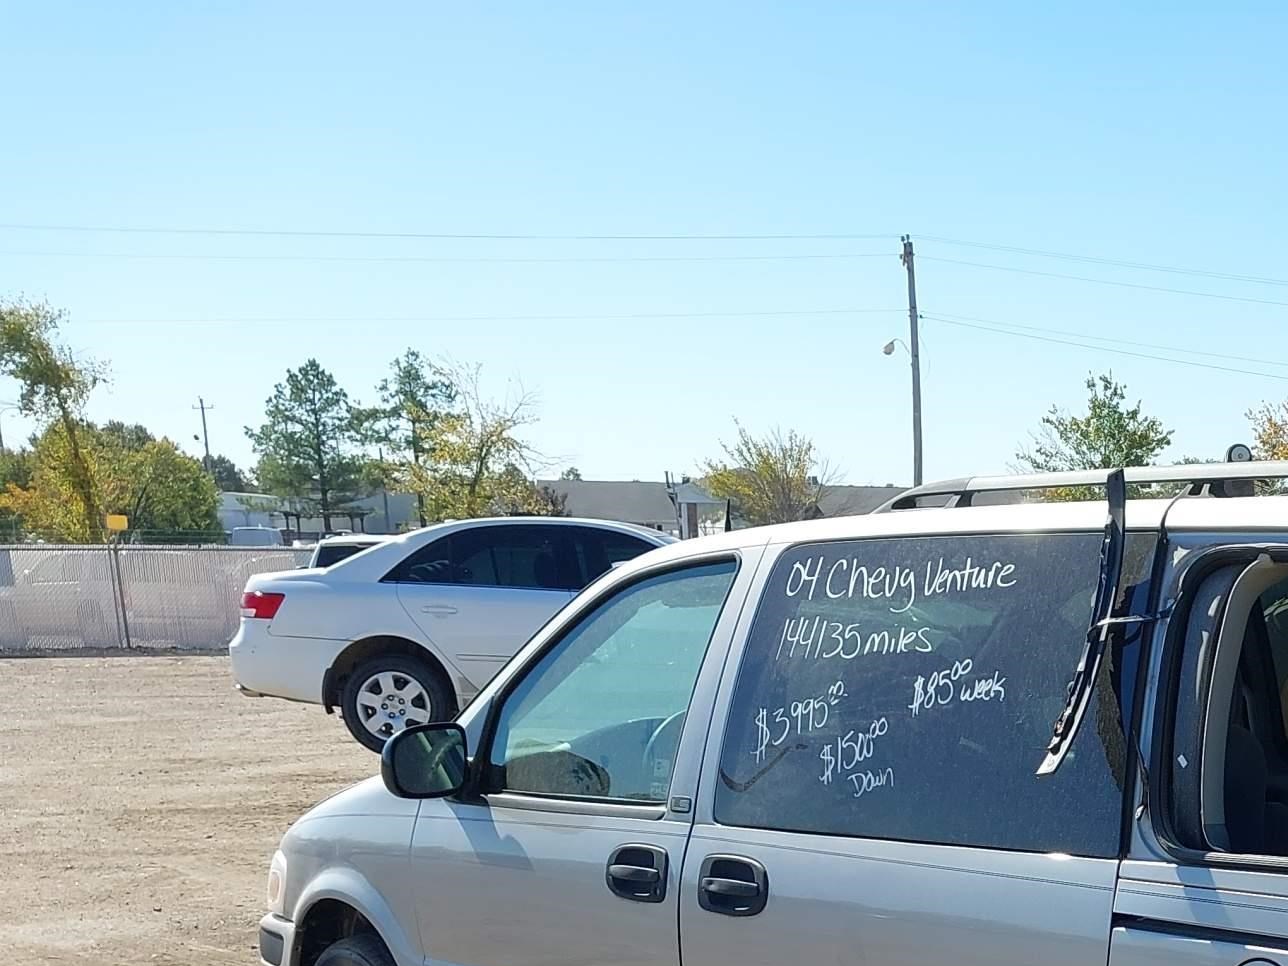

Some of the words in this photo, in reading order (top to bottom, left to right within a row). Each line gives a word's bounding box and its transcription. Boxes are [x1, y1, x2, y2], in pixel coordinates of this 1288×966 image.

[785, 556, 824, 601] 04
[826, 557, 916, 613] Chevy
[923, 557, 1017, 597] Venture
[863, 623, 933, 656] miles
[960, 671, 1006, 702] week
[847, 767, 895, 798] Down
